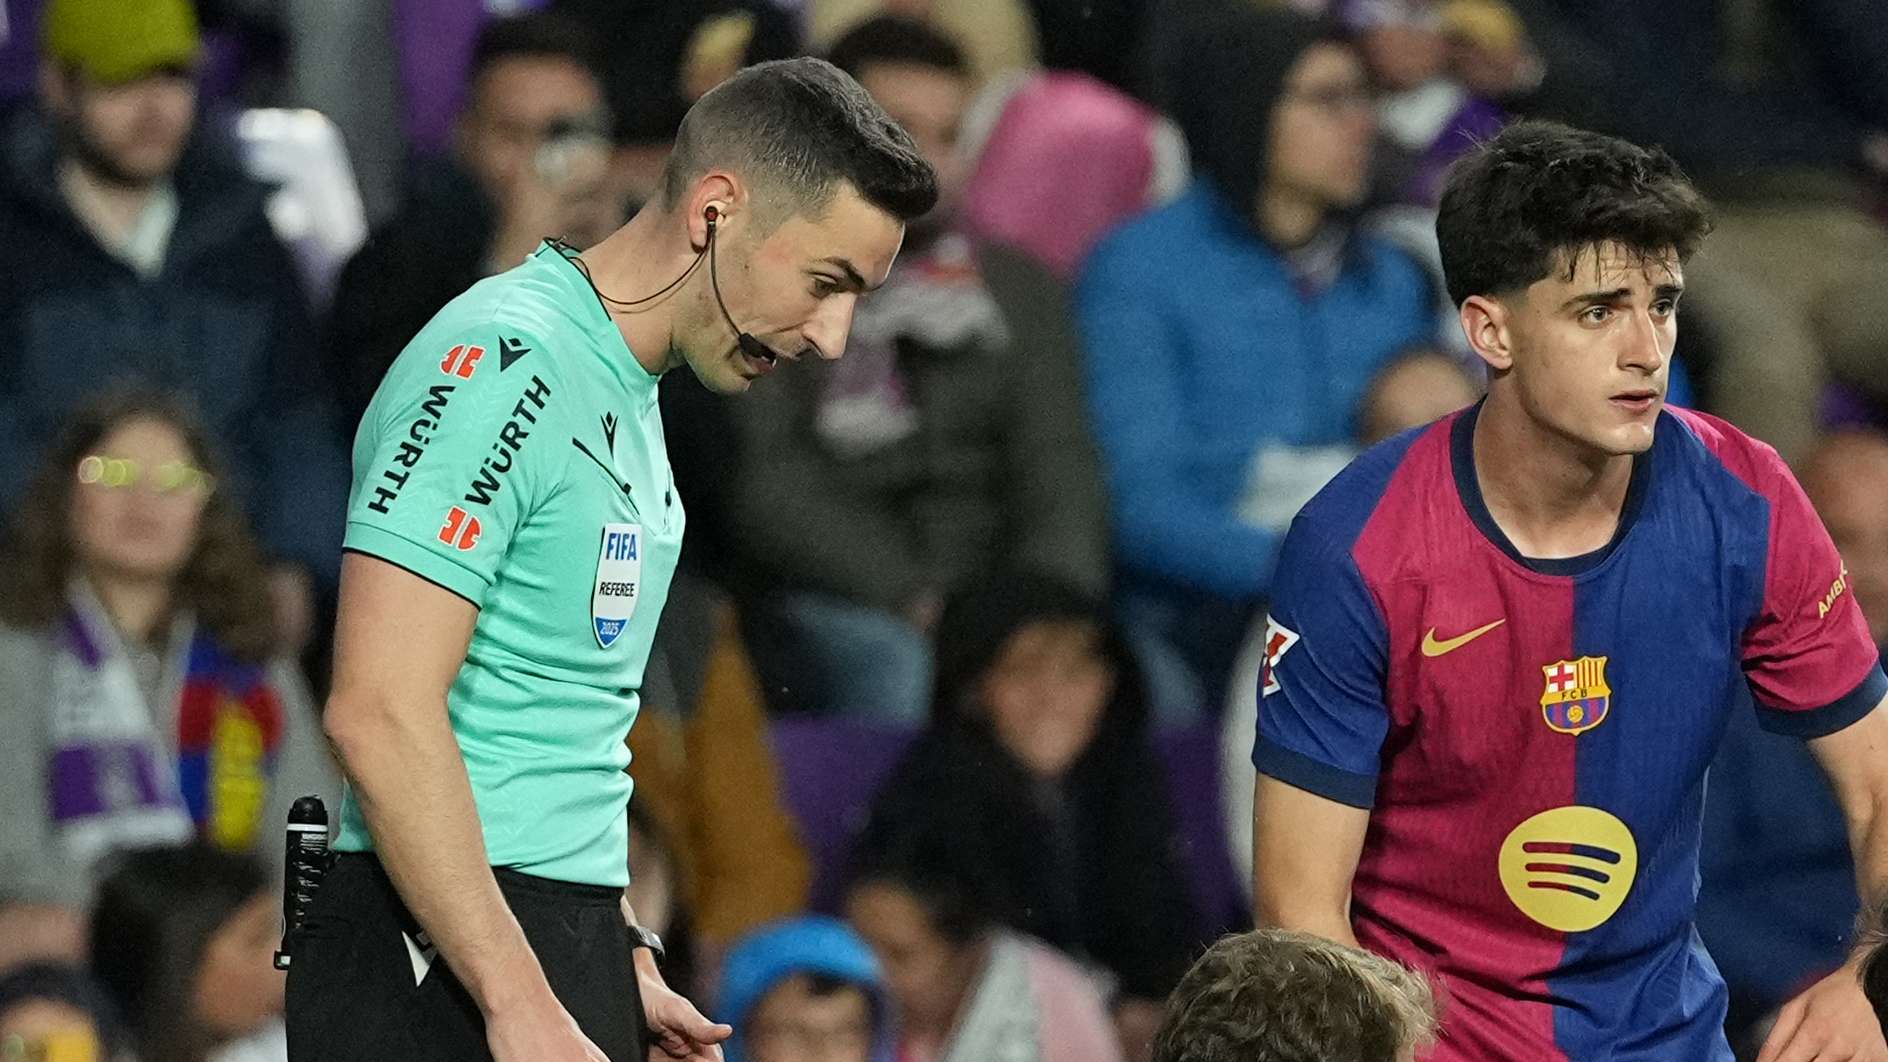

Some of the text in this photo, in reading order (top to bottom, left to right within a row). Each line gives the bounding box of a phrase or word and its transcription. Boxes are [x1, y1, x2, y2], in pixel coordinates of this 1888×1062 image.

[368, 385, 455, 514] WÜRTH
[465, 375, 552, 507] WÜRTH
[606, 532, 637, 561] FIFA
[599, 582, 635, 597] REFEREE
